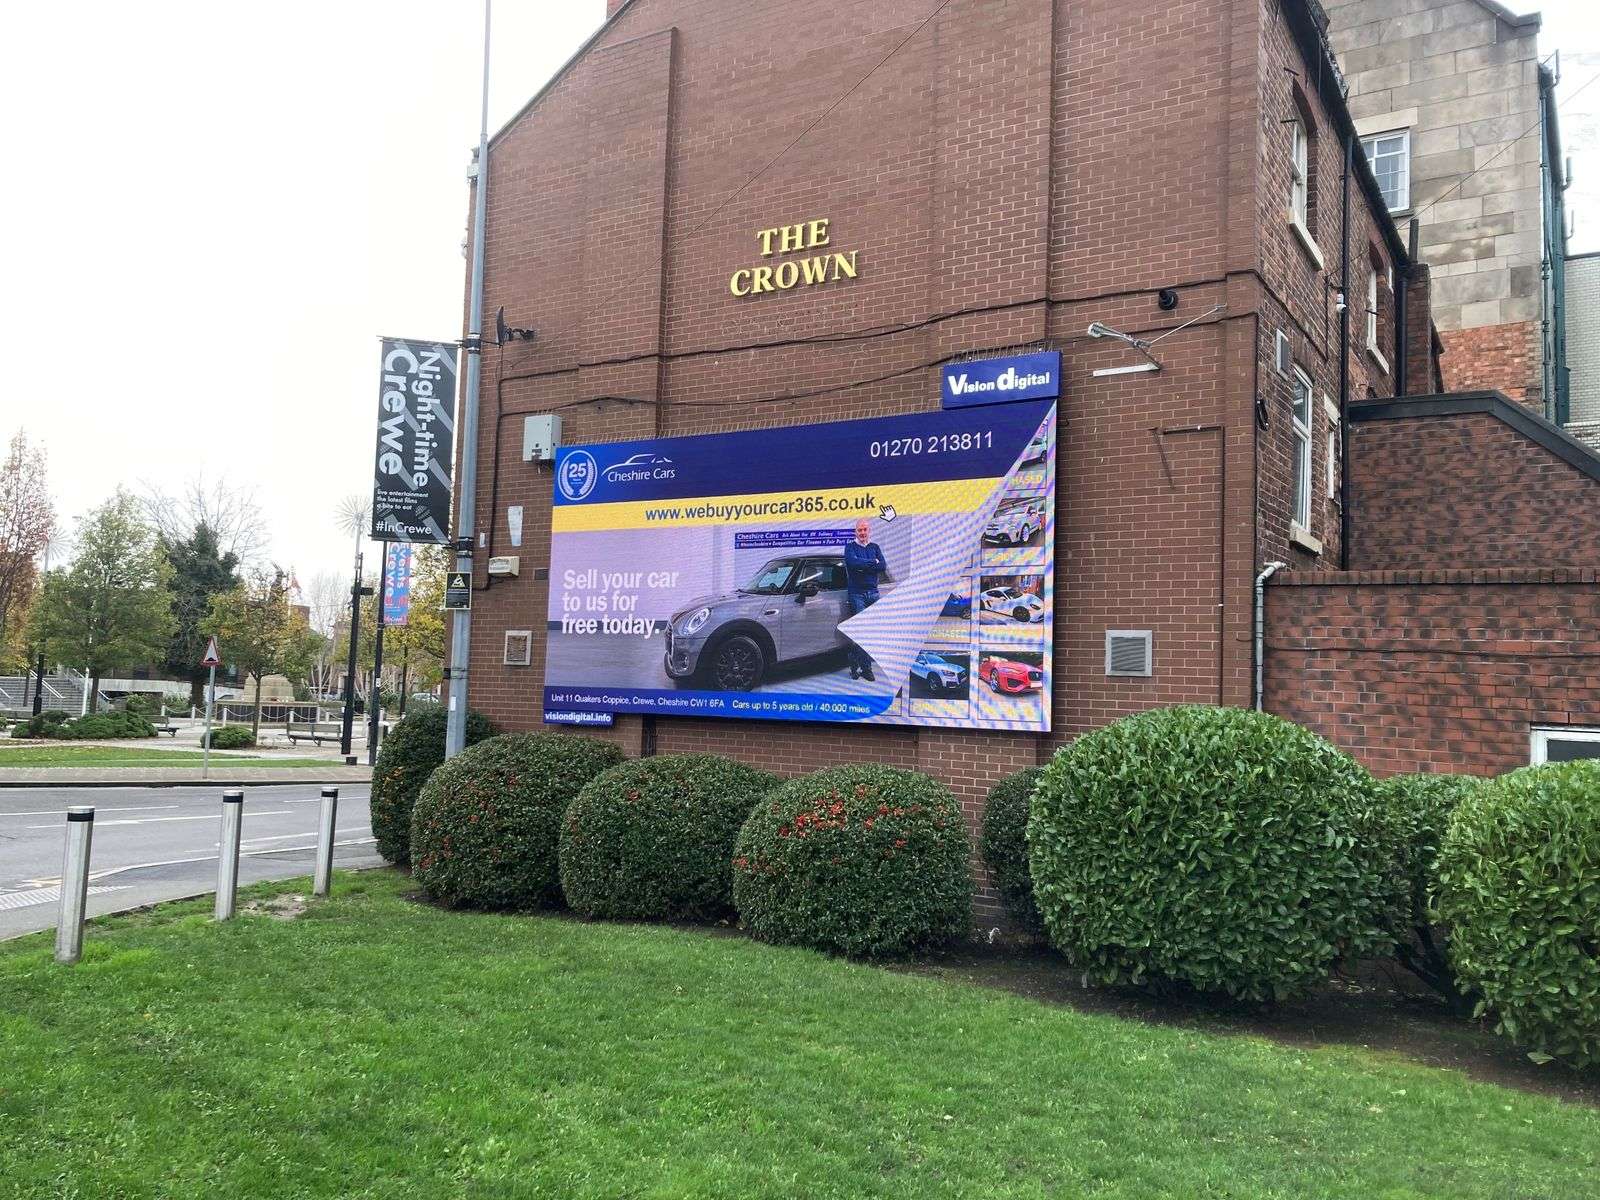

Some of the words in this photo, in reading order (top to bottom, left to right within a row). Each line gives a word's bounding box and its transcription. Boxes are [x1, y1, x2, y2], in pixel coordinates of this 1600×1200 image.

[757, 218, 830, 255] THE
[730, 250, 859, 296] CROWN
[948, 373, 995, 395] Vision
[997, 367, 1050, 391] digital
[379, 349, 419, 475] Crewe
[411, 350, 441, 487] Night-time
[870, 437, 922, 458] 01270
[927, 430, 993, 453] 213811
[568, 462, 587, 478] 25
[607, 470, 651, 482] Cheshire
[653, 468, 676, 480] Cars
[645, 493, 875, 521] www.webuyyourcar365.co.uk
[375, 520, 433, 535] #InCrewe
[563, 569, 598, 589] Sell
[602, 571, 643, 593] your
[647, 571, 680, 588] car
[562, 592, 580, 612] to
[586, 594, 608, 611] us
[612, 589, 639, 611] for
[561, 613, 598, 634] free
[601, 613, 660, 639] today.
[551, 694, 564, 702] Unit
[565, 694, 573, 702] 11
[574, 694, 602, 703] Quakers
[658, 697, 689, 706] Cheshire
[690, 698, 708, 708] CW1
[709, 699, 725, 708] 6FA
[732, 699, 750, 709] Cars
[752, 701, 762, 711] up
[763, 701, 770, 709] to
[772, 701, 777, 710] 5
[779, 703, 800, 712] years
[801, 702, 813, 711] old
[849, 704, 870, 713] miles
[544, 711, 612, 723] visiondigital.info
